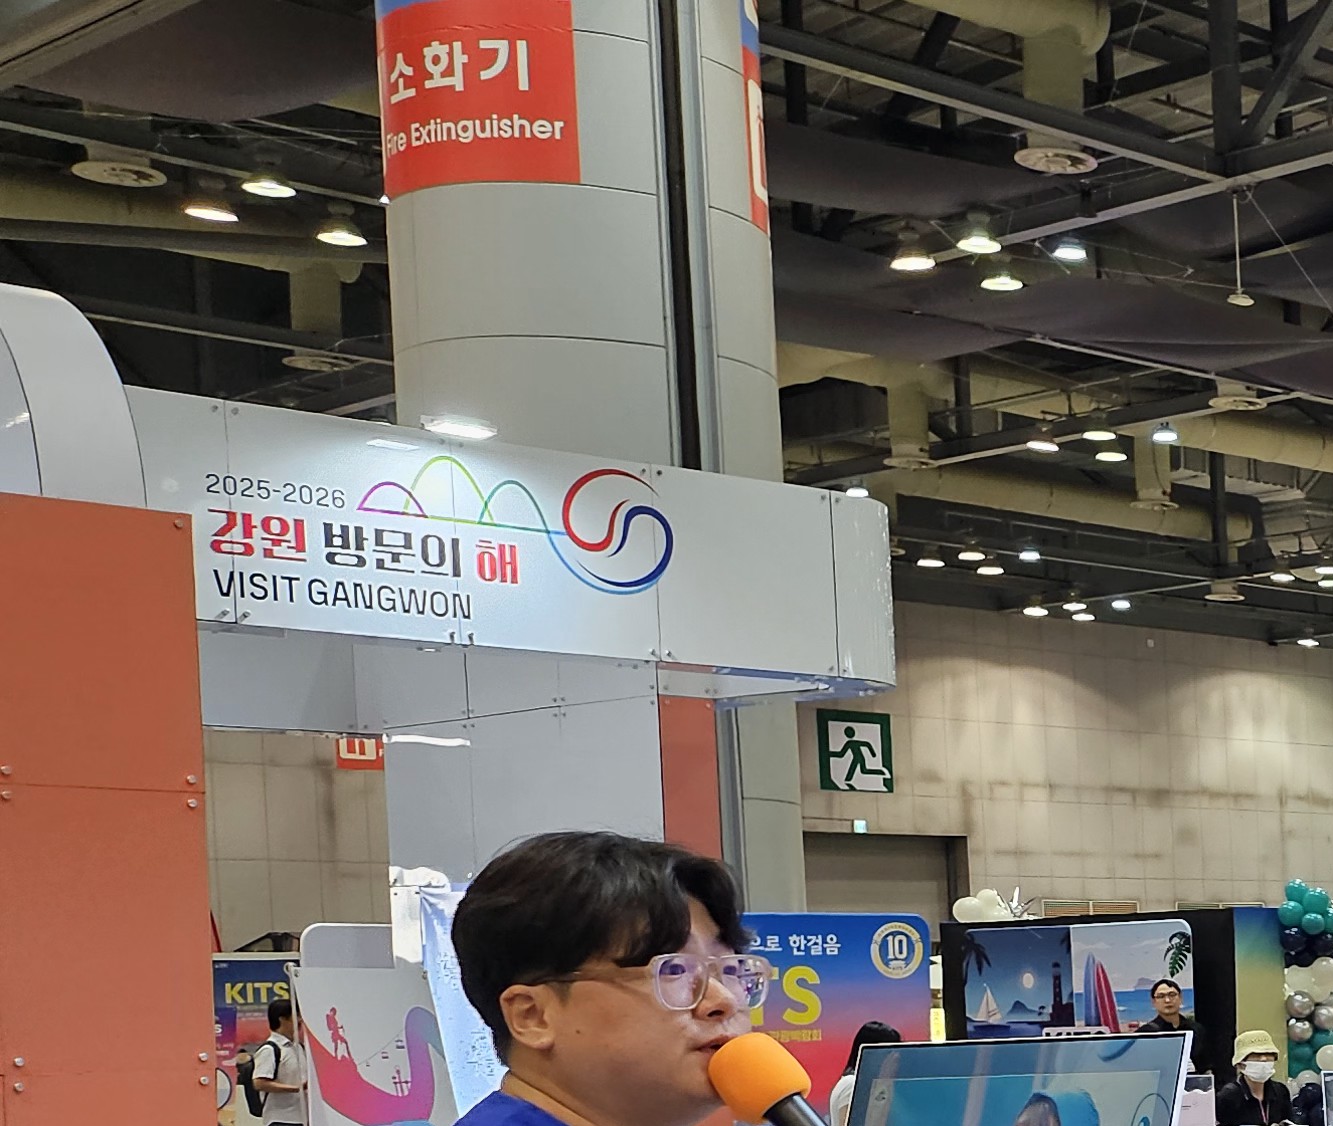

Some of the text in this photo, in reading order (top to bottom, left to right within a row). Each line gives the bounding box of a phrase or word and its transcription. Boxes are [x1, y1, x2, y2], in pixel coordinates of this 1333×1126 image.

[389, 39, 530, 105] 소화기
[386, 113, 565, 158] Fire Extinguisher
[204, 473, 346, 510] 2025-2026
[206, 507, 520, 585] 강원 방문의 해
[212, 568, 472, 621] VISIT GANGWON
[750, 933, 842, 956] 으로 한걸음
[886, 934, 908, 960] 10
[224, 981, 290, 1005] KITS
